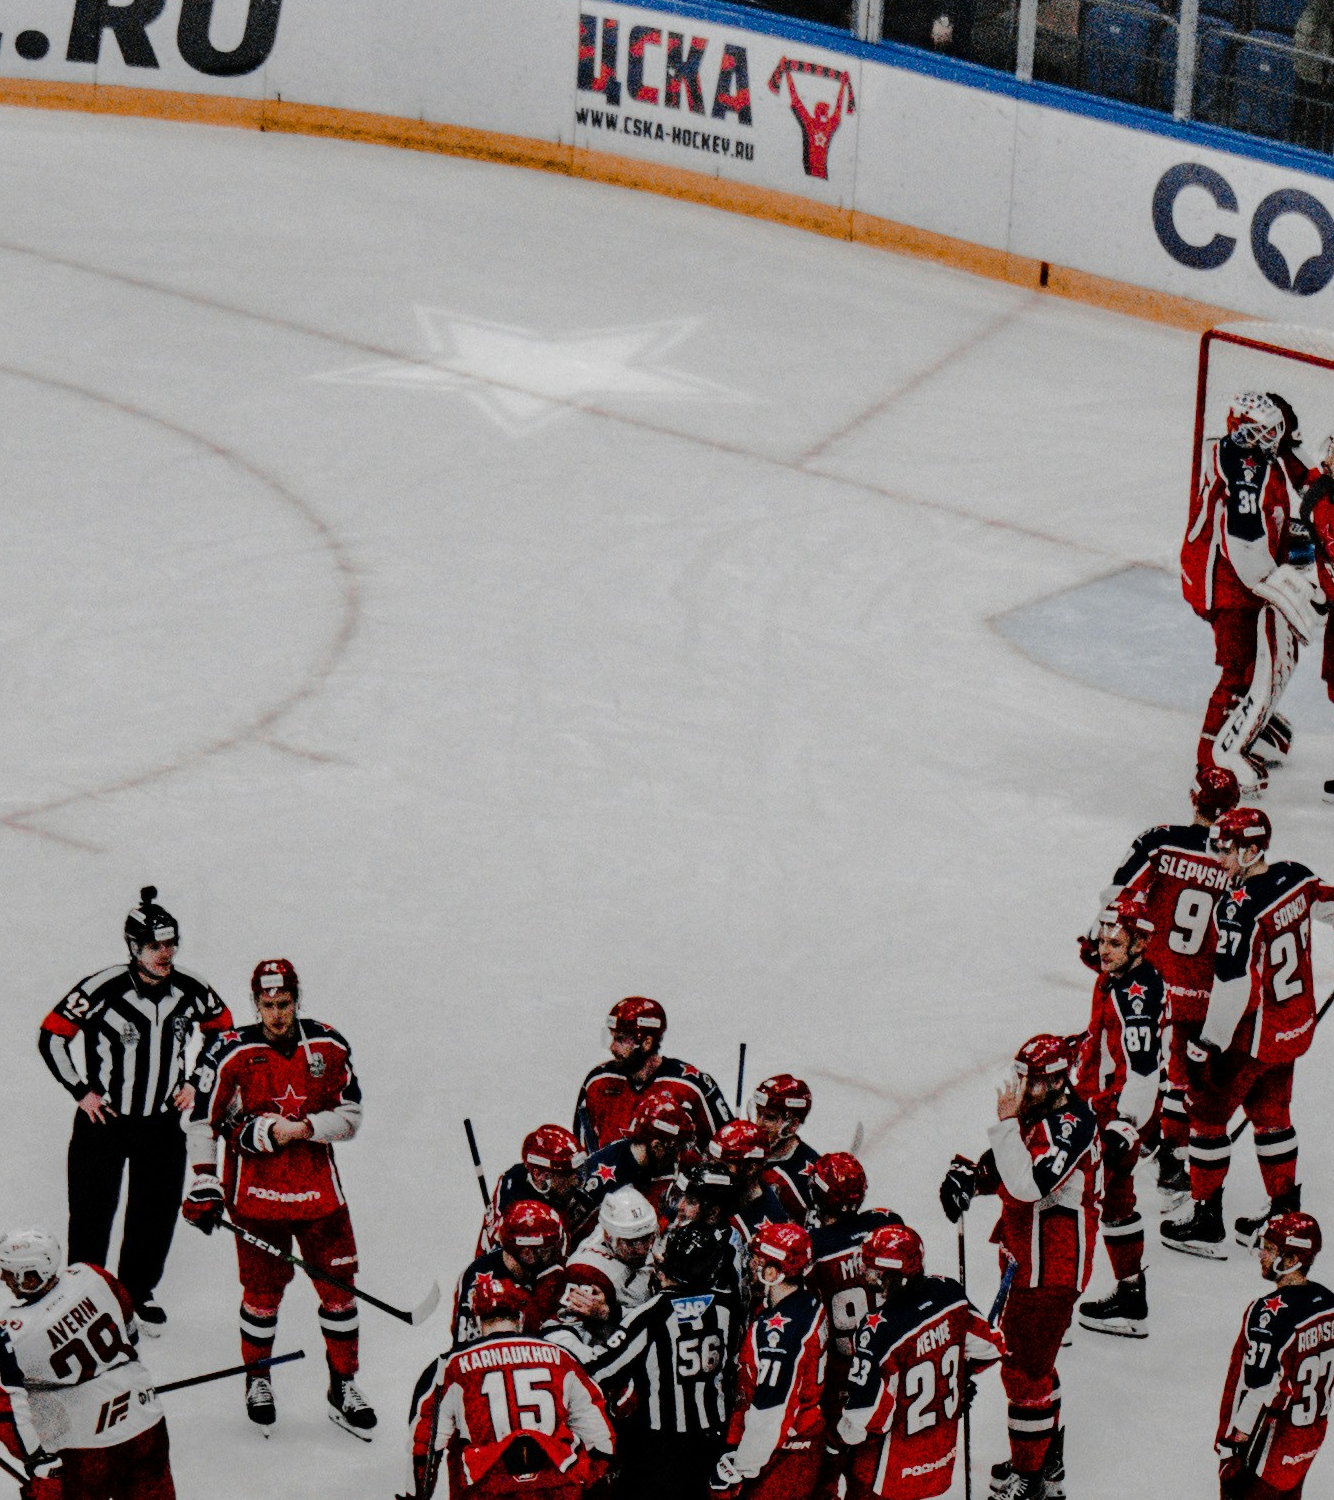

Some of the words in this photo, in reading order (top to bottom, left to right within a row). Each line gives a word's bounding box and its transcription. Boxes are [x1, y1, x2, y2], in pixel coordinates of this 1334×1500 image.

[576, 13, 754, 128] ЦСКА
[575, 106, 755, 162] WWW.CSKA-HOCKEY.RU
[1237, 491, 1257, 515] 31
[1124, 1026, 1152, 1052] 87
[45, 1296, 99, 1350] AVERIN
[673, 1299, 706, 1321] SAP
[458, 1345, 562, 1375] KARNAUKHOV
[677, 1333, 722, 1378] 56
[479, 1366, 557, 1443] 15
[905, 1344, 960, 1436] 23
